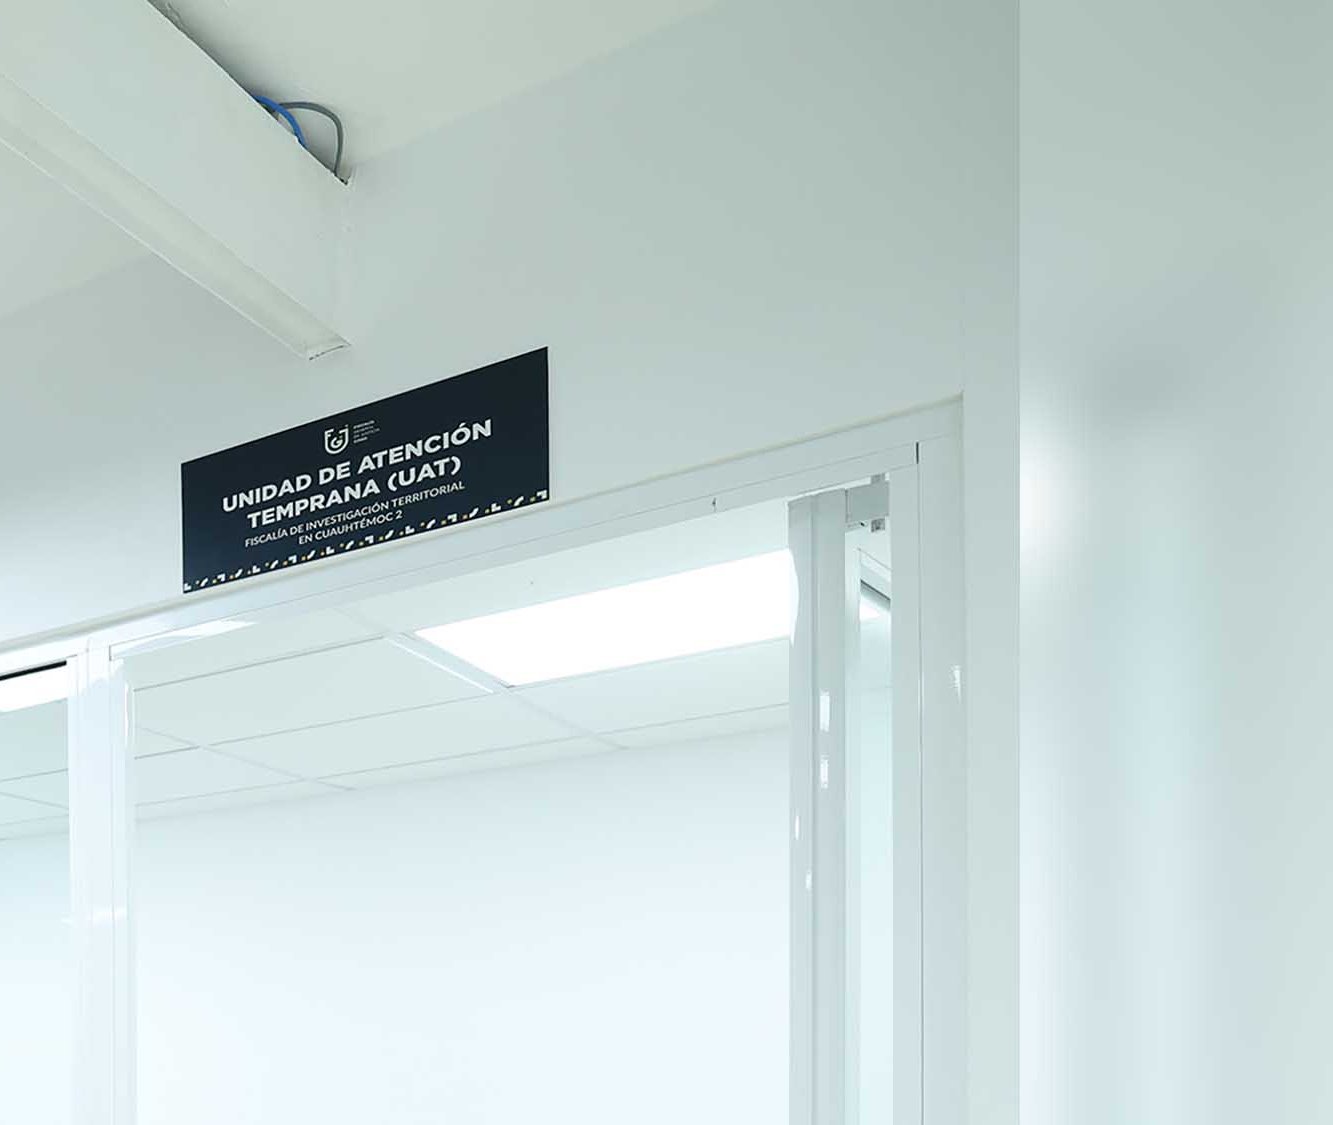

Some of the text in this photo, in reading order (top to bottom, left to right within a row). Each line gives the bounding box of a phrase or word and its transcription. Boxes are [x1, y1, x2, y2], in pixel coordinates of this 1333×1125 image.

[222, 473, 312, 512] UNIDAD
[318, 461, 351, 486] DE
[357, 419, 492, 474] ATENCIÓN
[247, 455, 461, 529] TEMPRANA (UAT)
[244, 480, 465, 547] FISCALÍA DE INVESTIGACIÓN TERRITORIAL
[298, 509, 403, 545] EN CUAUHTÉMOC 2
